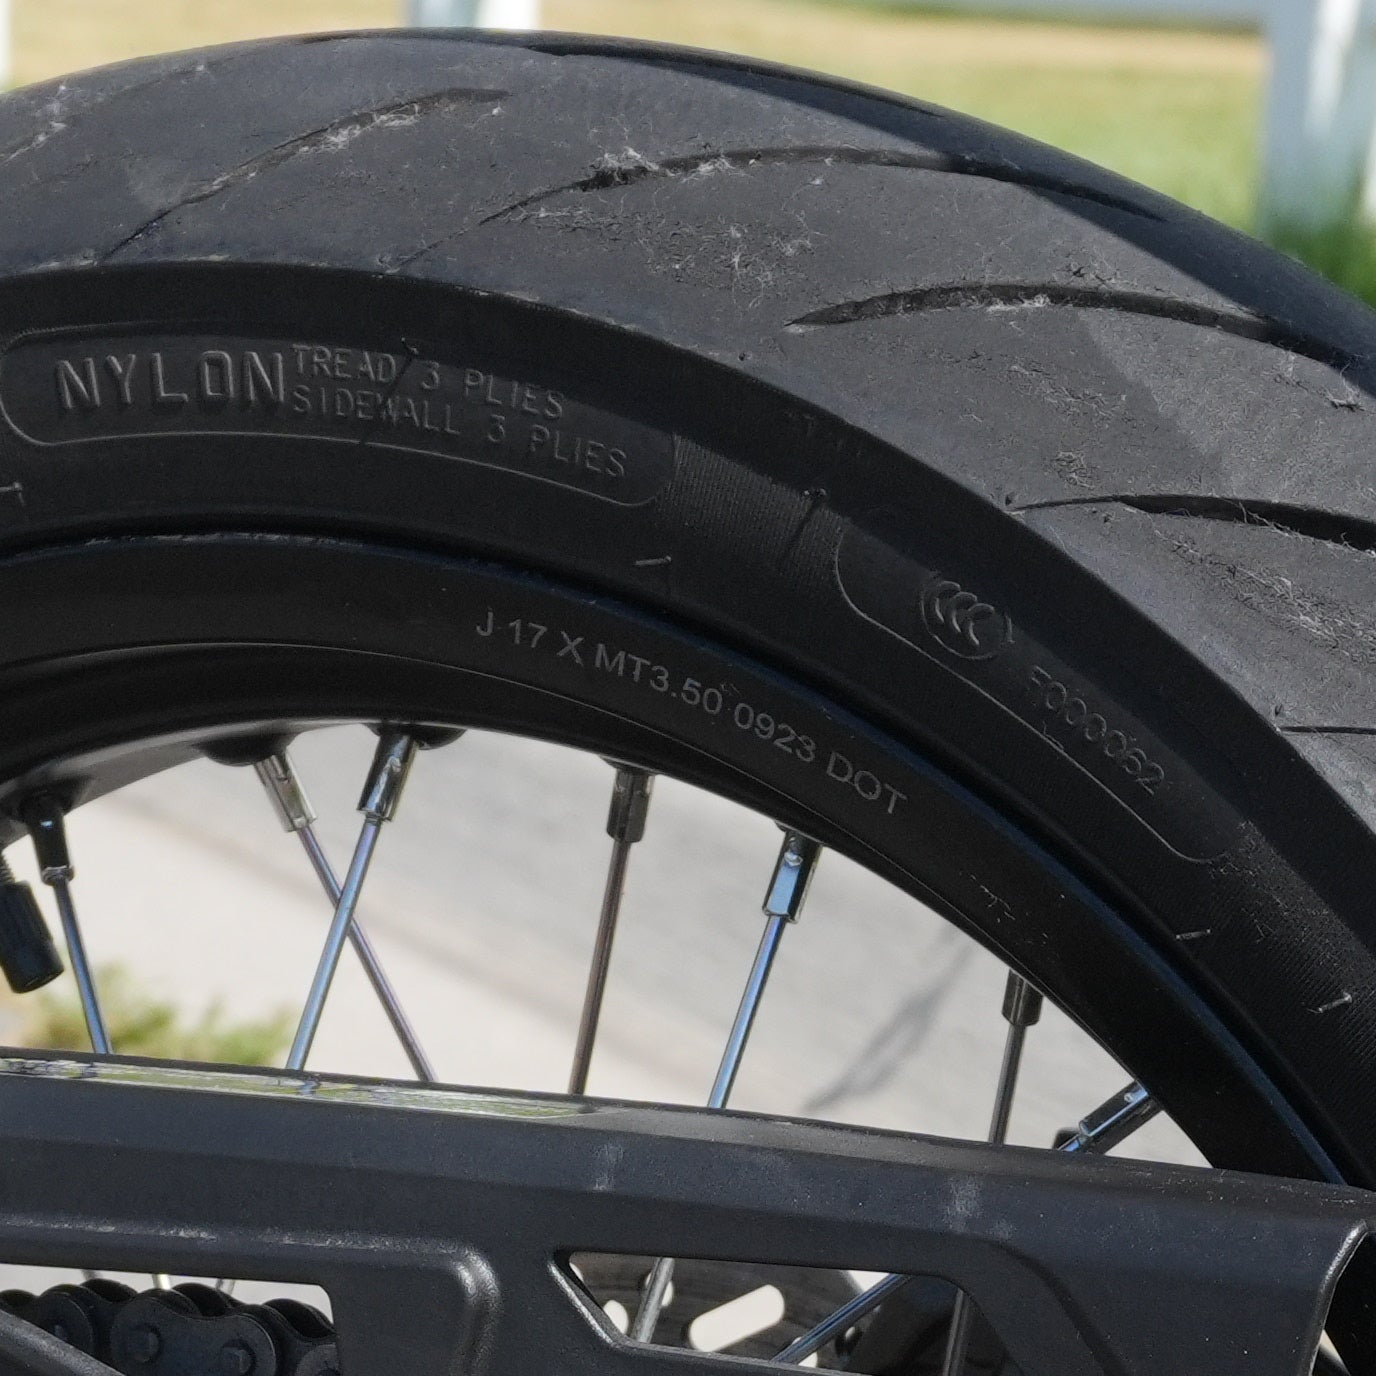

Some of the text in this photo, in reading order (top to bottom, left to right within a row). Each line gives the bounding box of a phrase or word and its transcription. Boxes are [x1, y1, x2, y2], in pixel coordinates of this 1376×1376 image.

[55, 350, 290, 411] NYLON
[292, 343, 566, 421] TREAD 3 PLIES
[292, 384, 628, 478] SIDEWALL 3 PLIES
[475, 611, 908, 816] J 17 X MT3.50 0923 DOT
